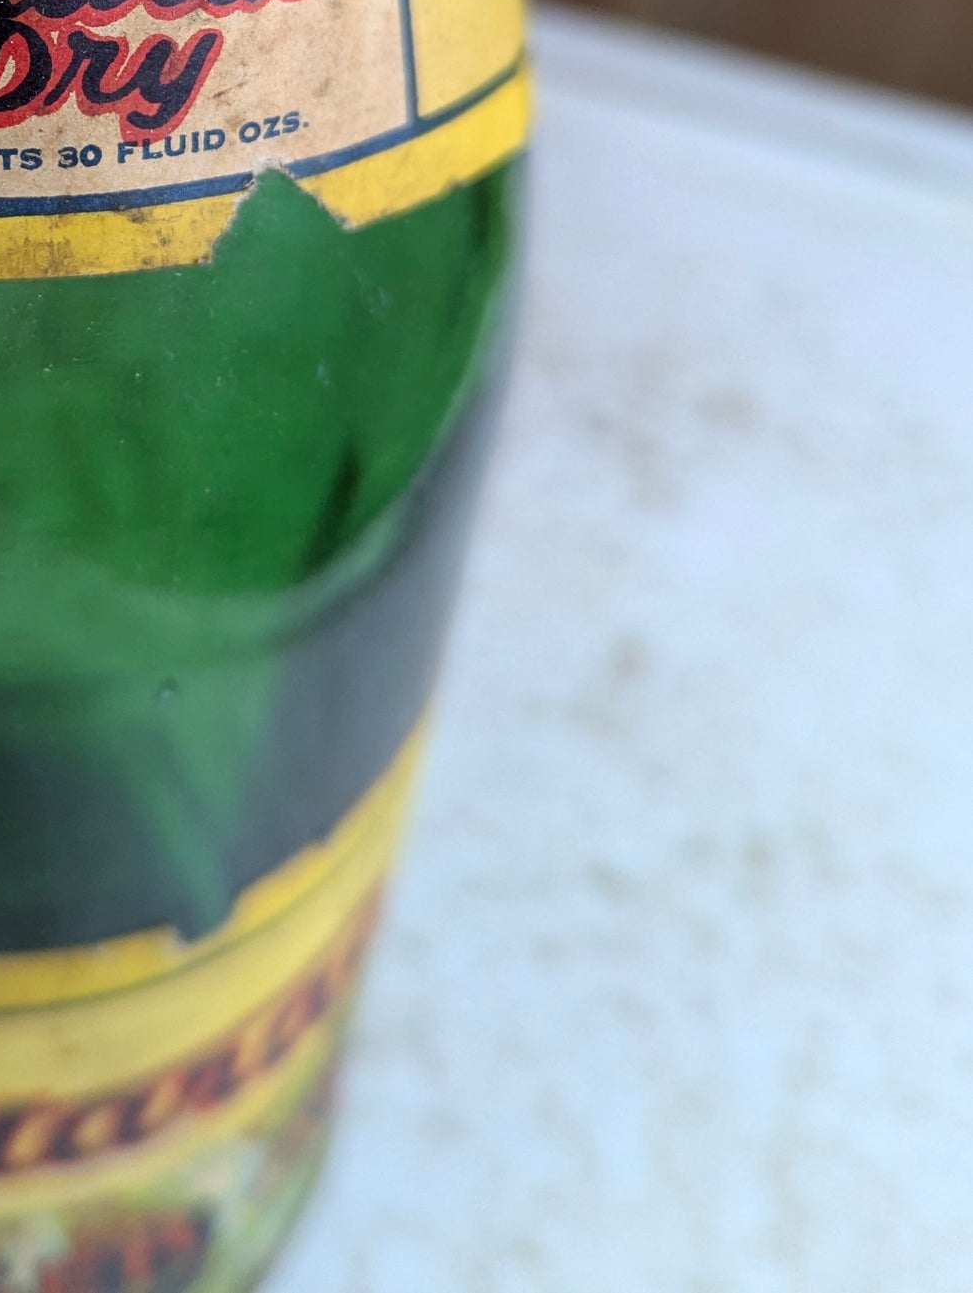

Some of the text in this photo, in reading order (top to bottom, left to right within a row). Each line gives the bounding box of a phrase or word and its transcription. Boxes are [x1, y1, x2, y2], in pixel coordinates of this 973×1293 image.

[57, 143, 102, 169] 30
[117, 128, 226, 164] FLUID
[238, 110, 310, 144] OZS.
